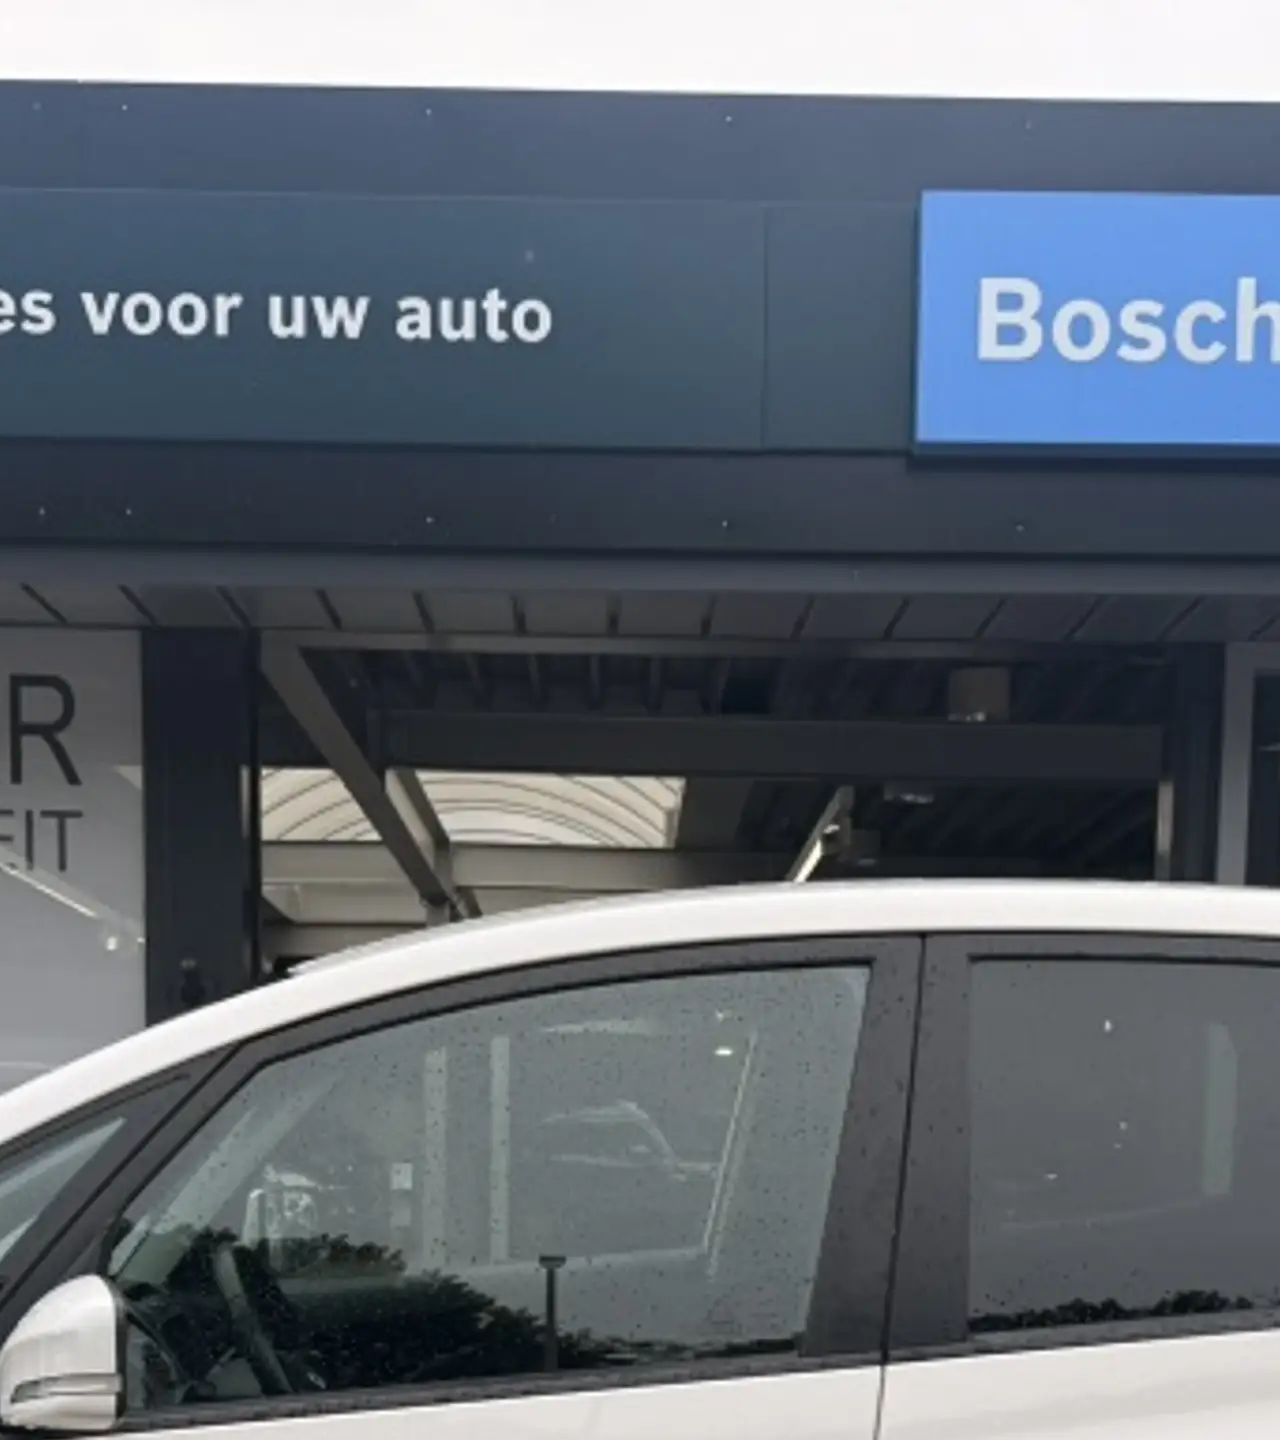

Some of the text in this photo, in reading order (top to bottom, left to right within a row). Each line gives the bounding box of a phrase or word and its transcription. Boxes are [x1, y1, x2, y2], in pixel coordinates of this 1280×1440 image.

[81, 287, 242, 338] voor
[267, 297, 370, 340] uw
[395, 288, 553, 343] auto
